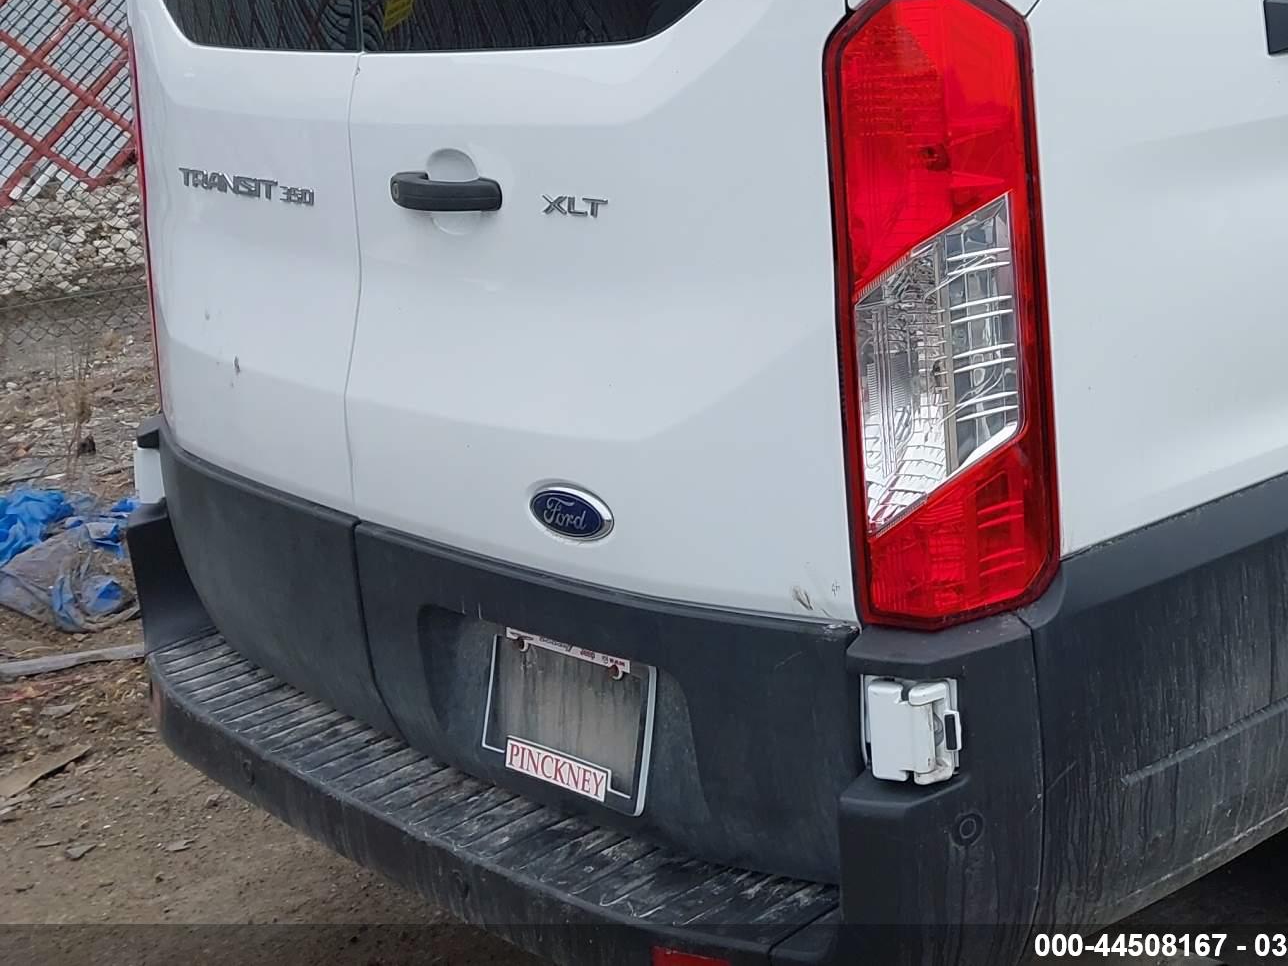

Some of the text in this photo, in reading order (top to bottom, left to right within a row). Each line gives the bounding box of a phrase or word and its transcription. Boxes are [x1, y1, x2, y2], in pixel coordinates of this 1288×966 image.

[179, 167, 315, 206] TRANSIT 350
[542, 194, 609, 218] XLT
[544, 497, 588, 530] Ford
[509, 742, 605, 798] PINCKNEY
